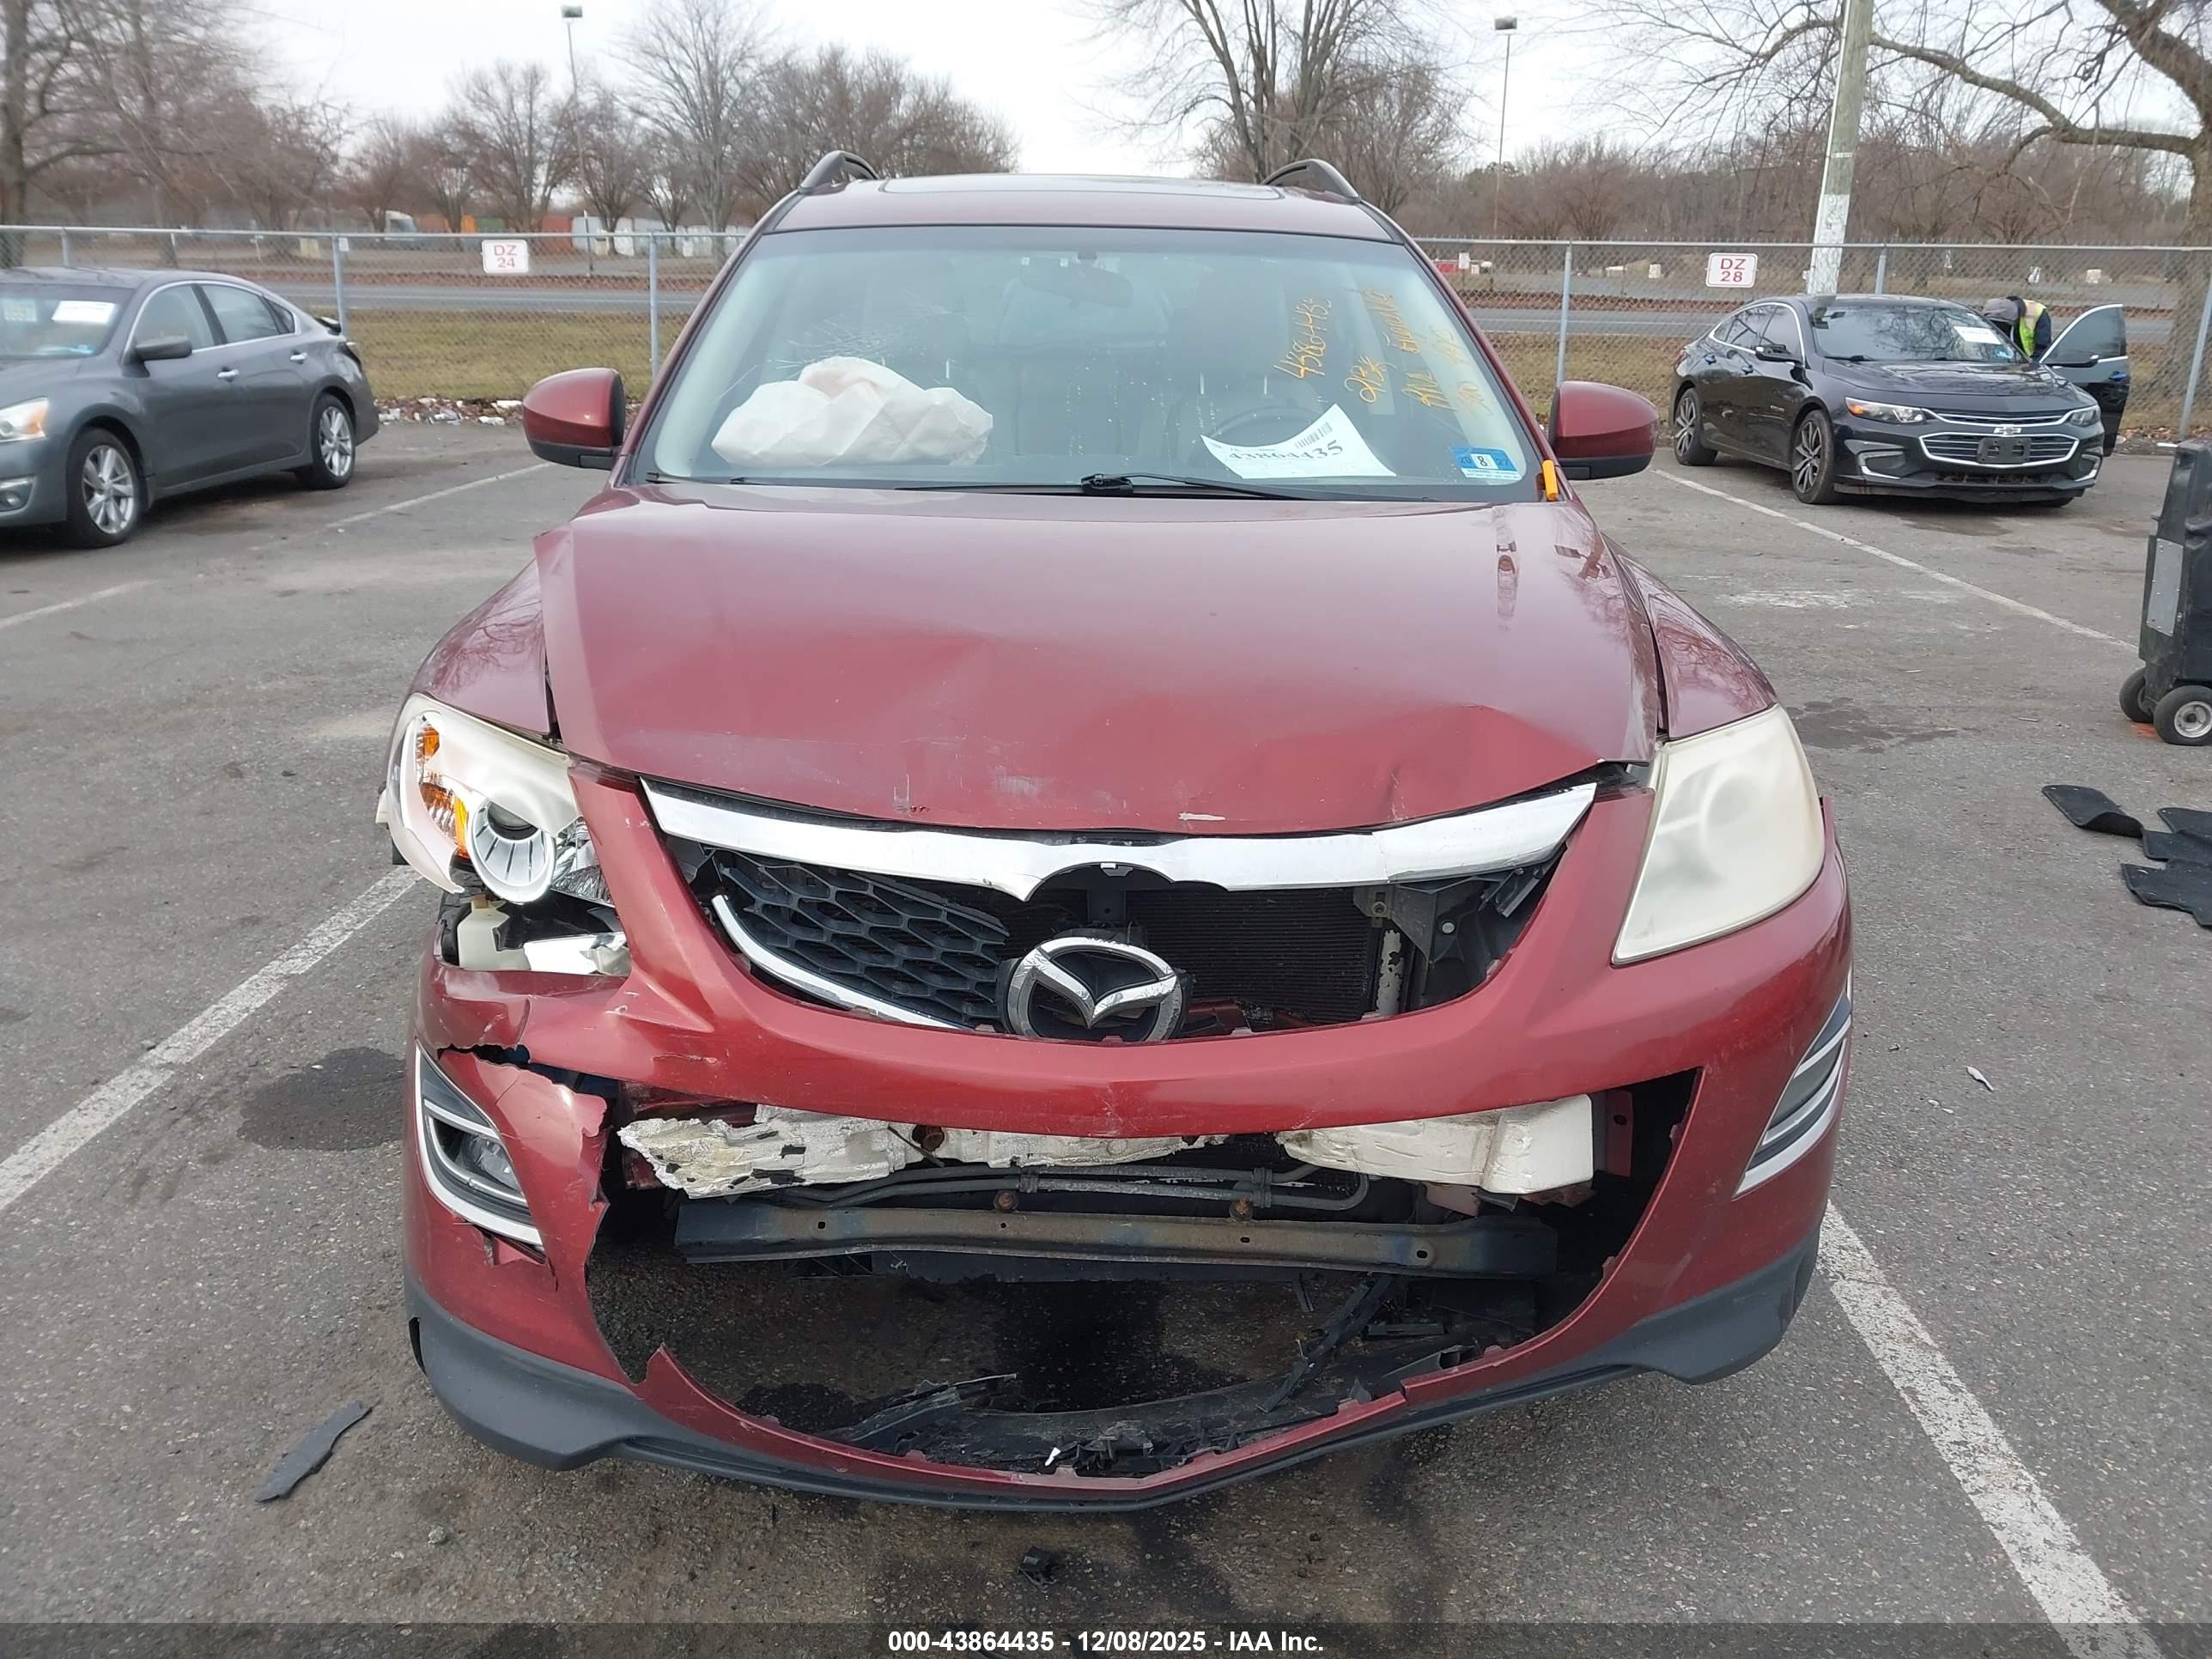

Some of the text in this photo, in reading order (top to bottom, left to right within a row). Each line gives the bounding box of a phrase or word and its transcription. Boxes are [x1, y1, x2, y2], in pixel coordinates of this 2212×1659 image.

[494, 245, 517, 256] DZ
[497, 257, 515, 268] 24
[1720, 258, 1747, 270] DZ
[1720, 270, 1743, 283] 28
[1476, 455, 1489, 467] 8
